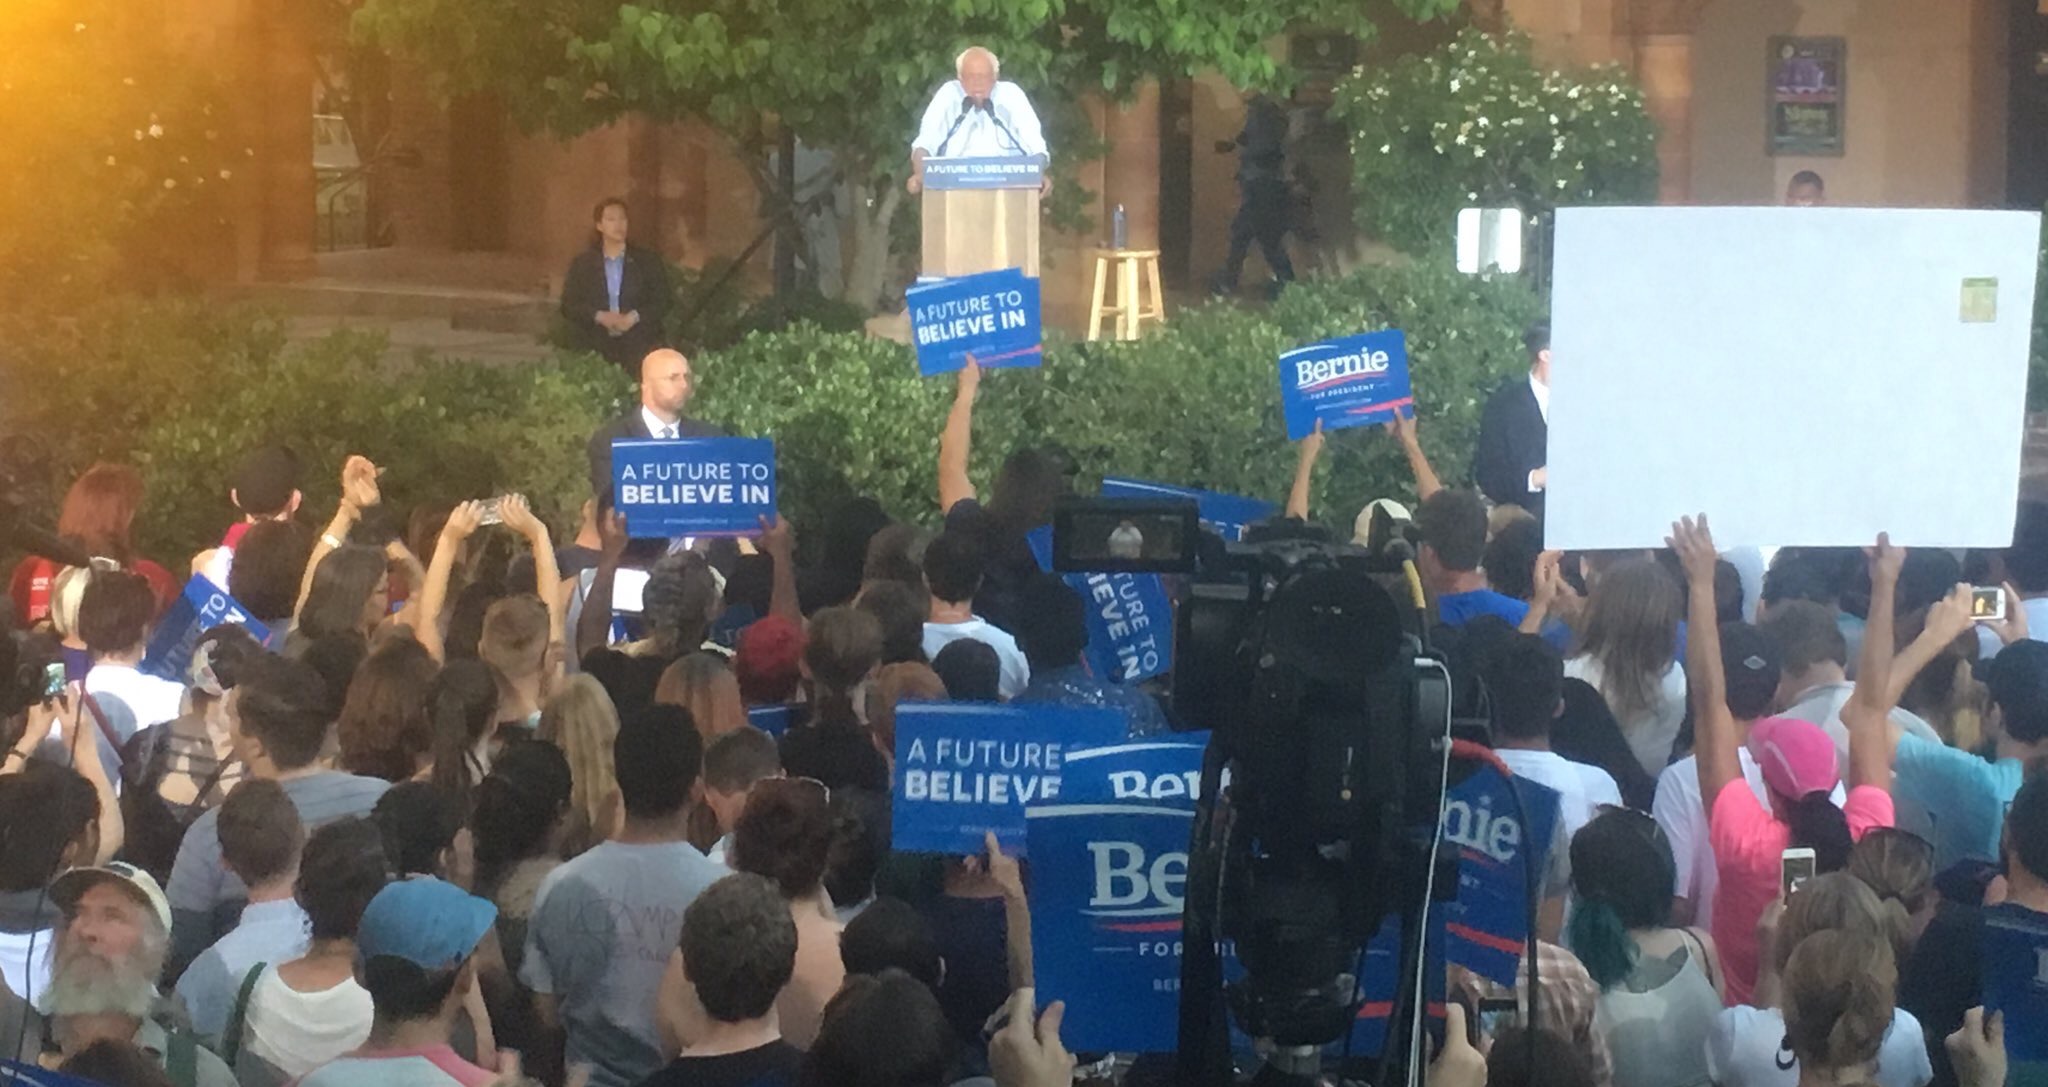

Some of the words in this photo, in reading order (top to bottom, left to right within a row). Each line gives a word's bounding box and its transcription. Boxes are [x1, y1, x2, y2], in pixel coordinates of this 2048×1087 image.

[935, 165, 968, 174] FUTURE
[970, 165, 983, 174] TO
[984, 165, 1025, 174] BELIEVE
[1027, 165, 1039, 174] IN
[916, 307, 926, 323] A
[927, 295, 992, 320] FUTURE
[995, 290, 1022, 307] TO
[918, 314, 996, 345] BELIEVE
[1001, 309, 1026, 330] IN
[1295, 346, 1389, 386] Bernie
[621, 463, 637, 481] A
[642, 463, 731, 481] FUTURE
[738, 463, 769, 481] TO
[621, 484, 734, 504] BELIEVE
[741, 485, 770, 504] IN
[200, 593, 226, 619] TO
[1113, 572, 1149, 632] TURE
[1140, 634, 1158, 671] TO
[1085, 572, 1130, 640] IEVE
[1117, 644, 1141, 679] IN
[907, 737, 927, 764] A
[936, 737, 1062, 770] FUTURE
[905, 768, 1062, 804] BELIEVE
[1443, 795, 1521, 864] nie
